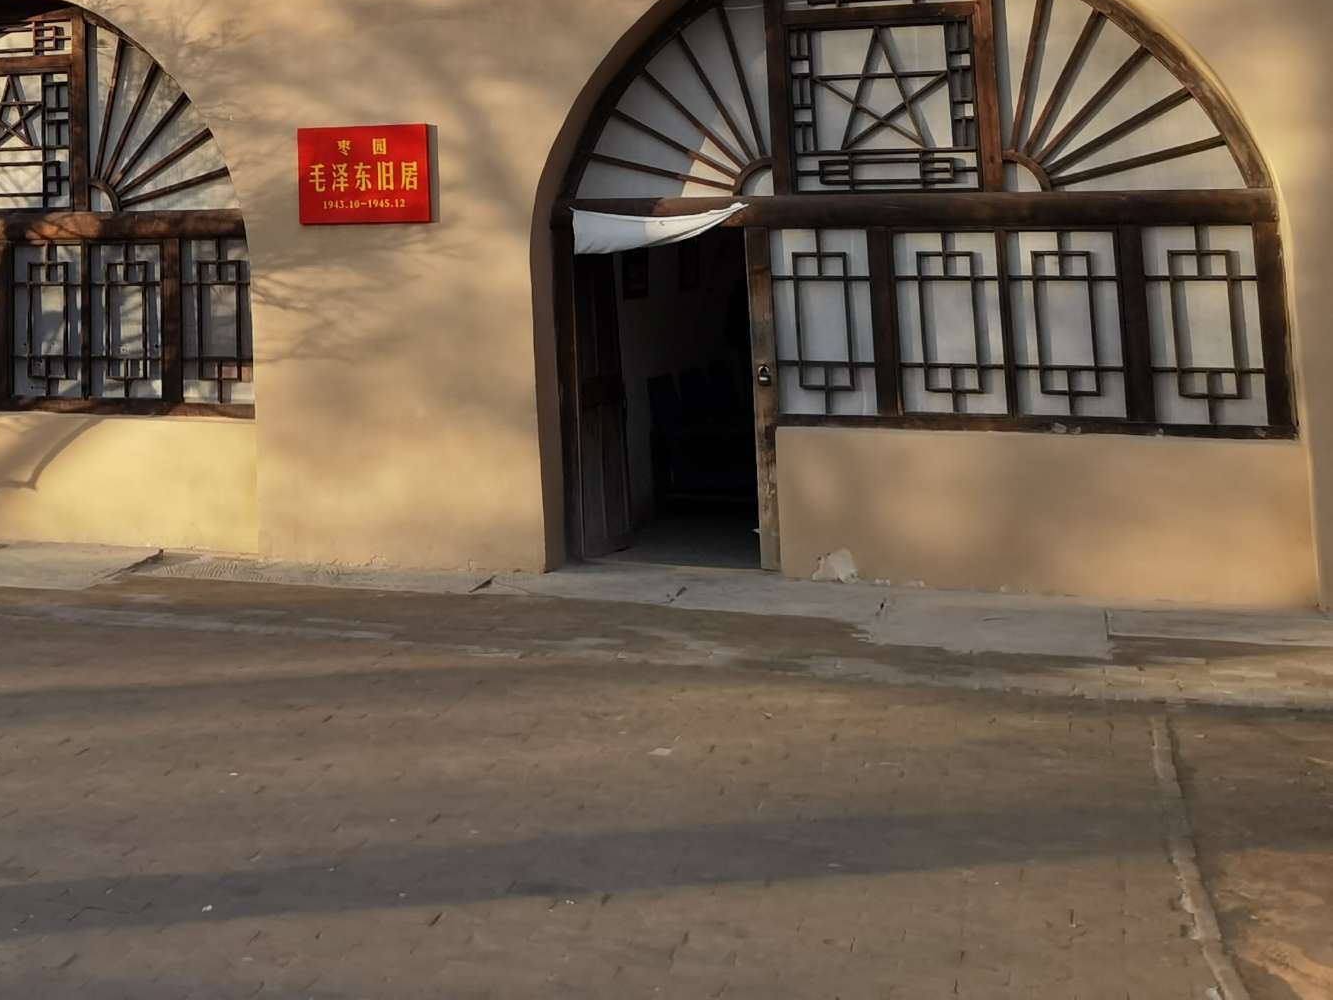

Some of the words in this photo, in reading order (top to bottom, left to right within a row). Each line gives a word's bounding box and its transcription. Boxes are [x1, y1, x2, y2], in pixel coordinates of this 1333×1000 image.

[337, 138, 387, 156] 枣园
[309, 161, 418, 192] 毛泽东旧居
